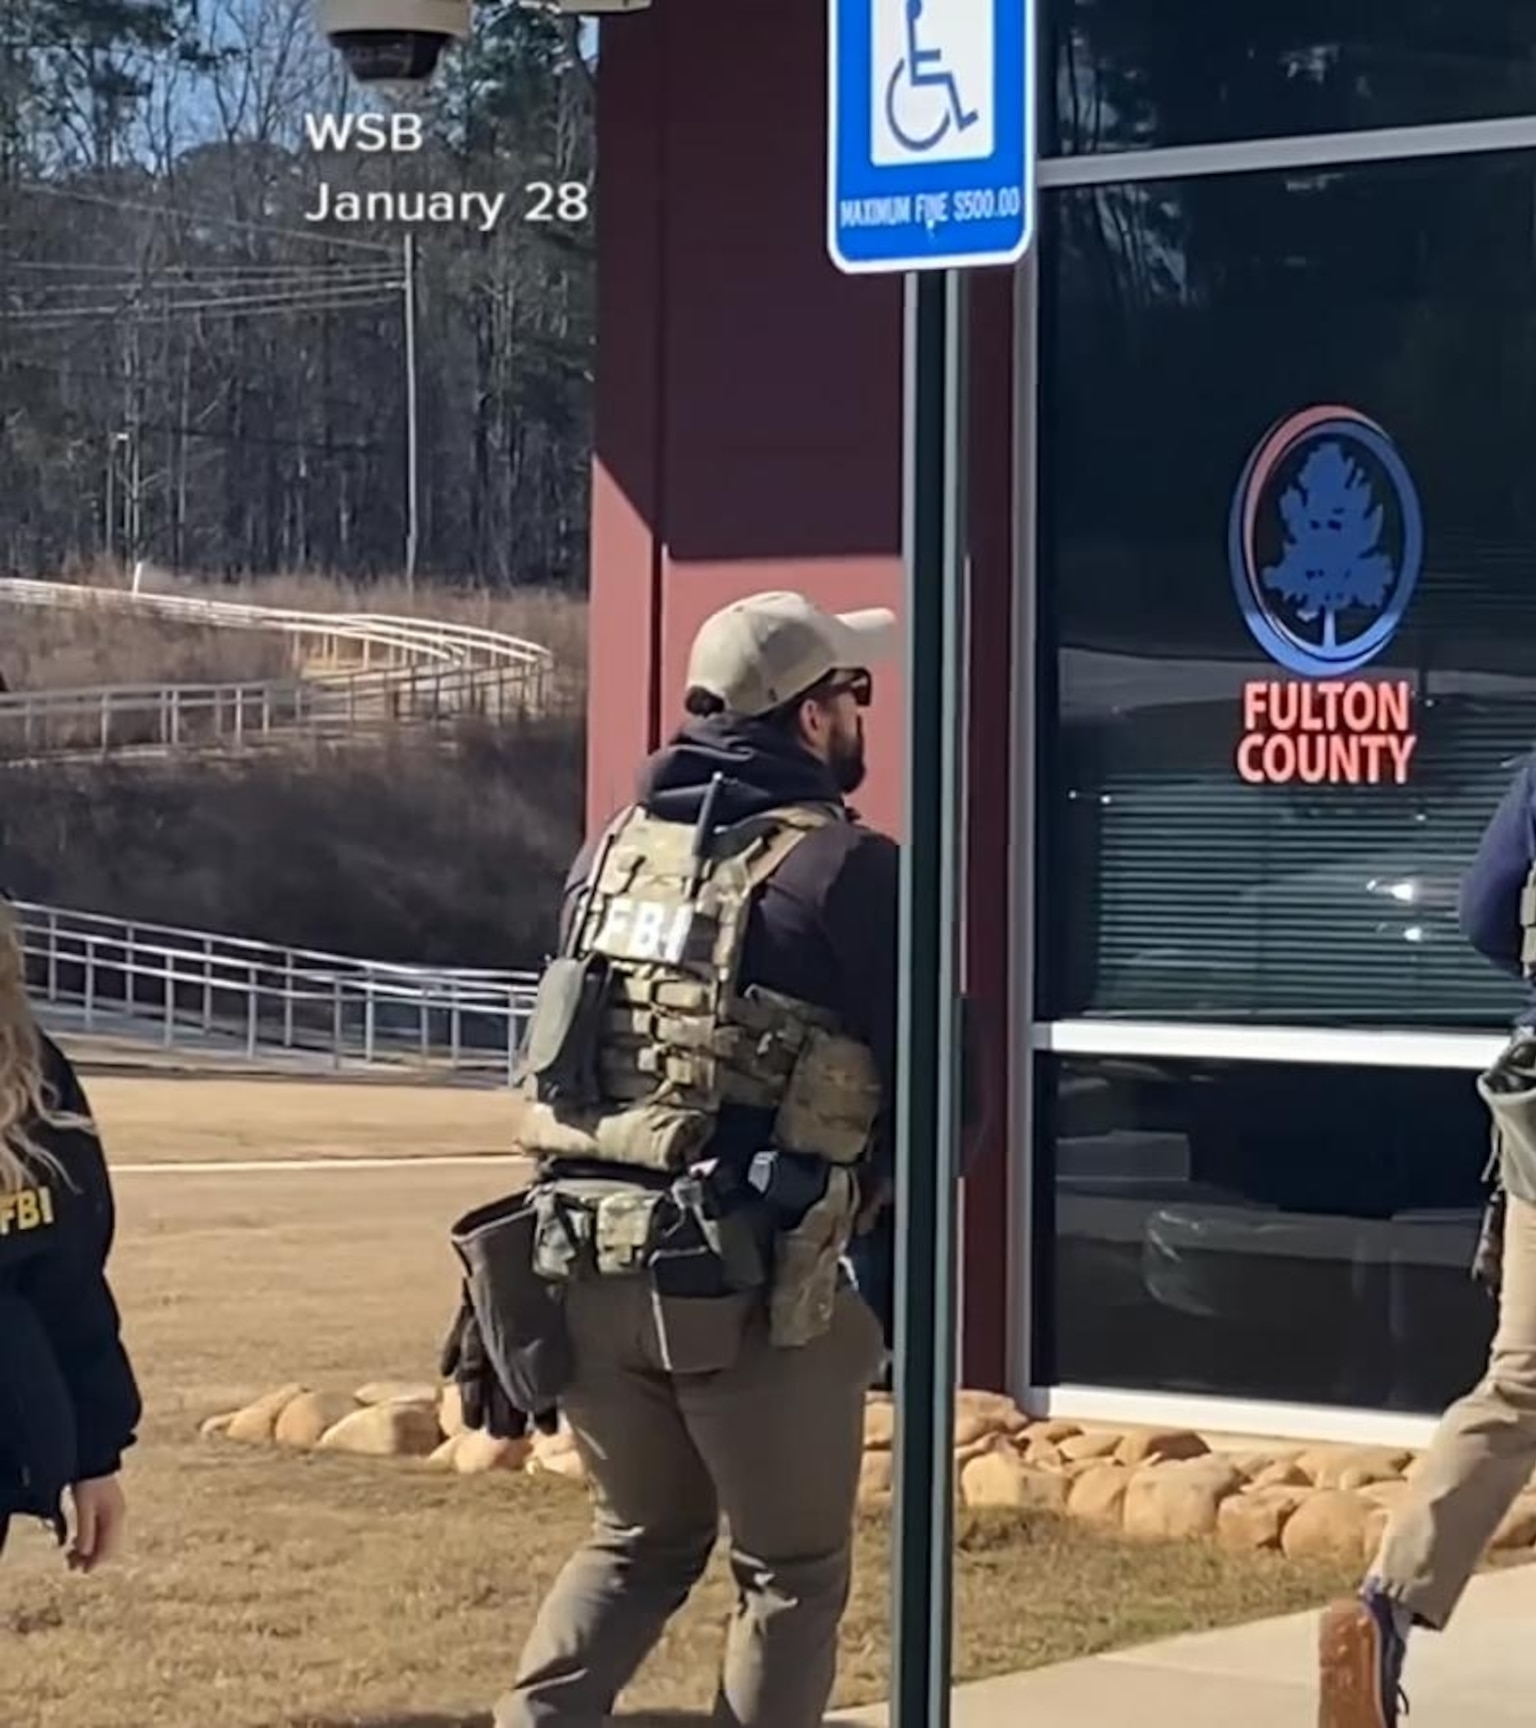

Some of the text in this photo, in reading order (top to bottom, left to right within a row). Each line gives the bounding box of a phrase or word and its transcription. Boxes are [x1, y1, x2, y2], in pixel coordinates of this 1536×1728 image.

[840, 196, 911, 228] MAXIMUM
[1244, 681, 1409, 731] FULTON
[1237, 732, 1416, 784] COUNTY
[592, 898, 694, 964] FBI
[0, 1186, 54, 1235] FBI
